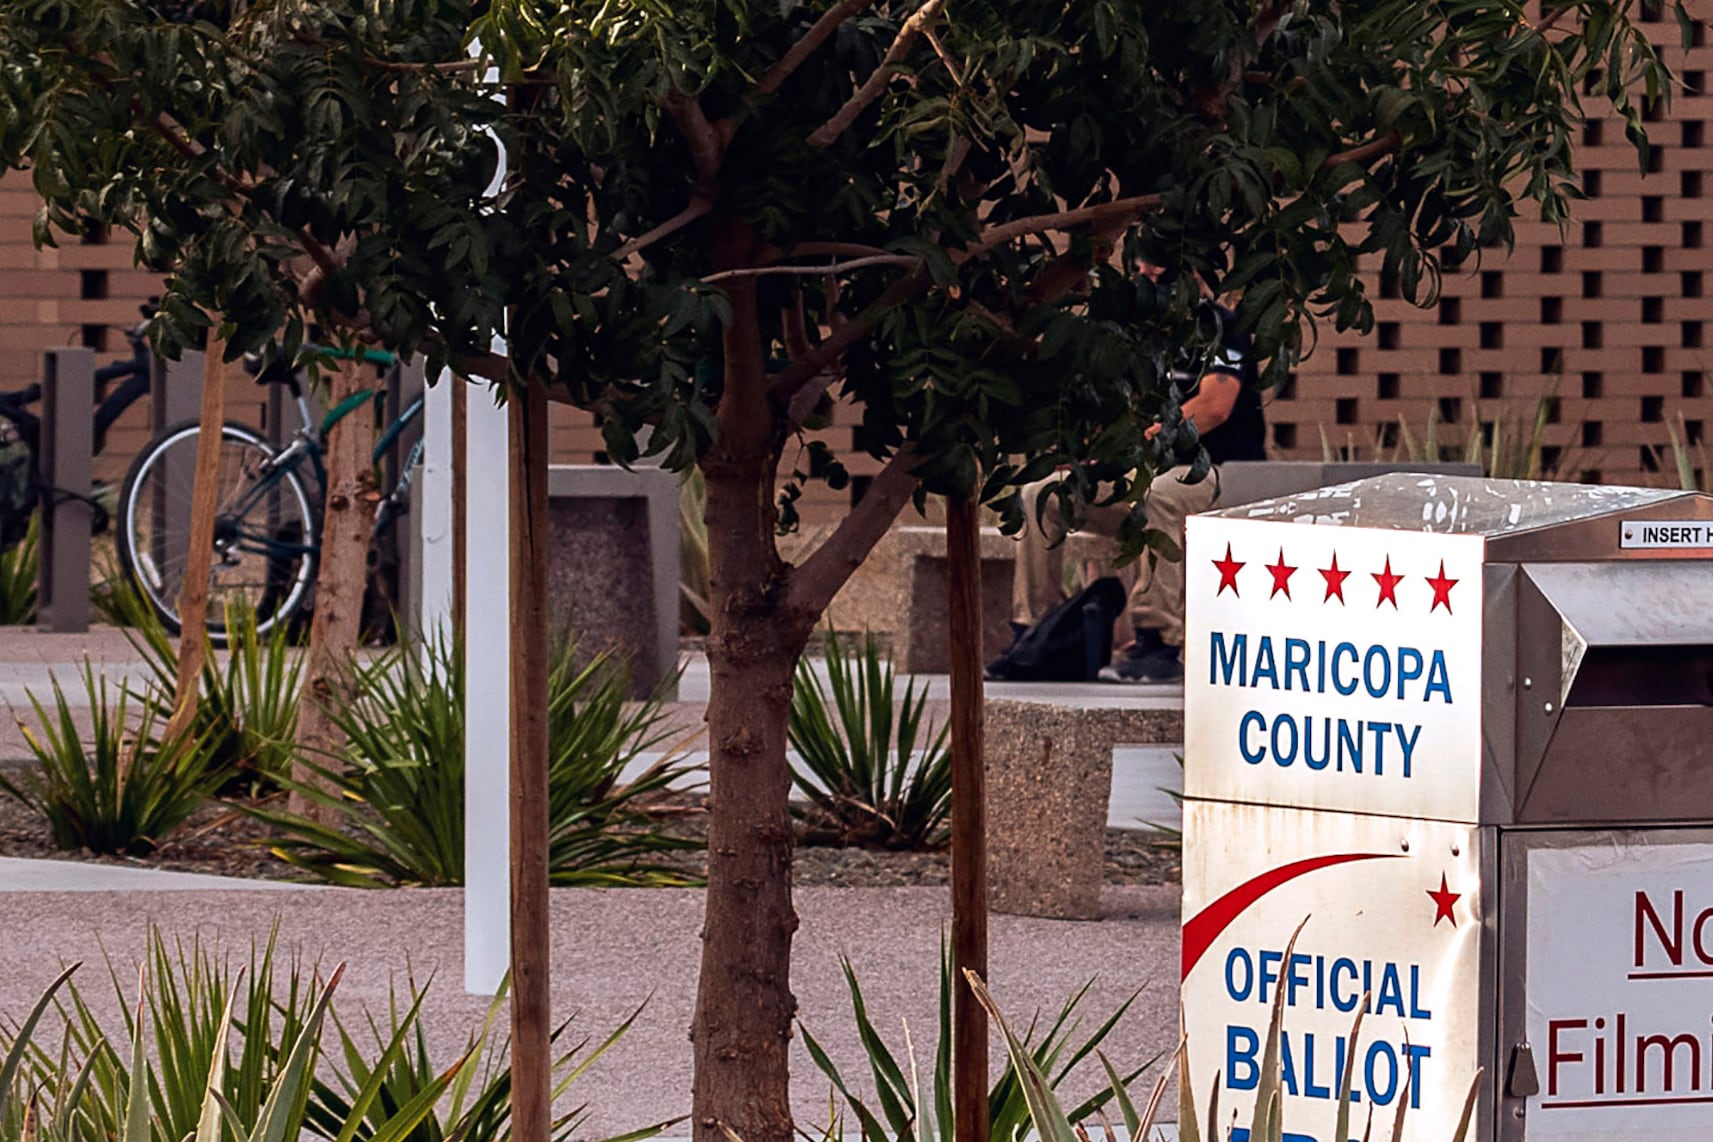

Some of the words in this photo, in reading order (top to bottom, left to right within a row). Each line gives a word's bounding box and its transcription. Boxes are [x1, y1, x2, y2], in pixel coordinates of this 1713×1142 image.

[1643, 527, 1702, 543] INSERT
[1210, 631, 1454, 704] MARICOPA
[1238, 710, 1422, 778] COUNTY
[1225, 947, 1432, 1020] OFFICIAL
